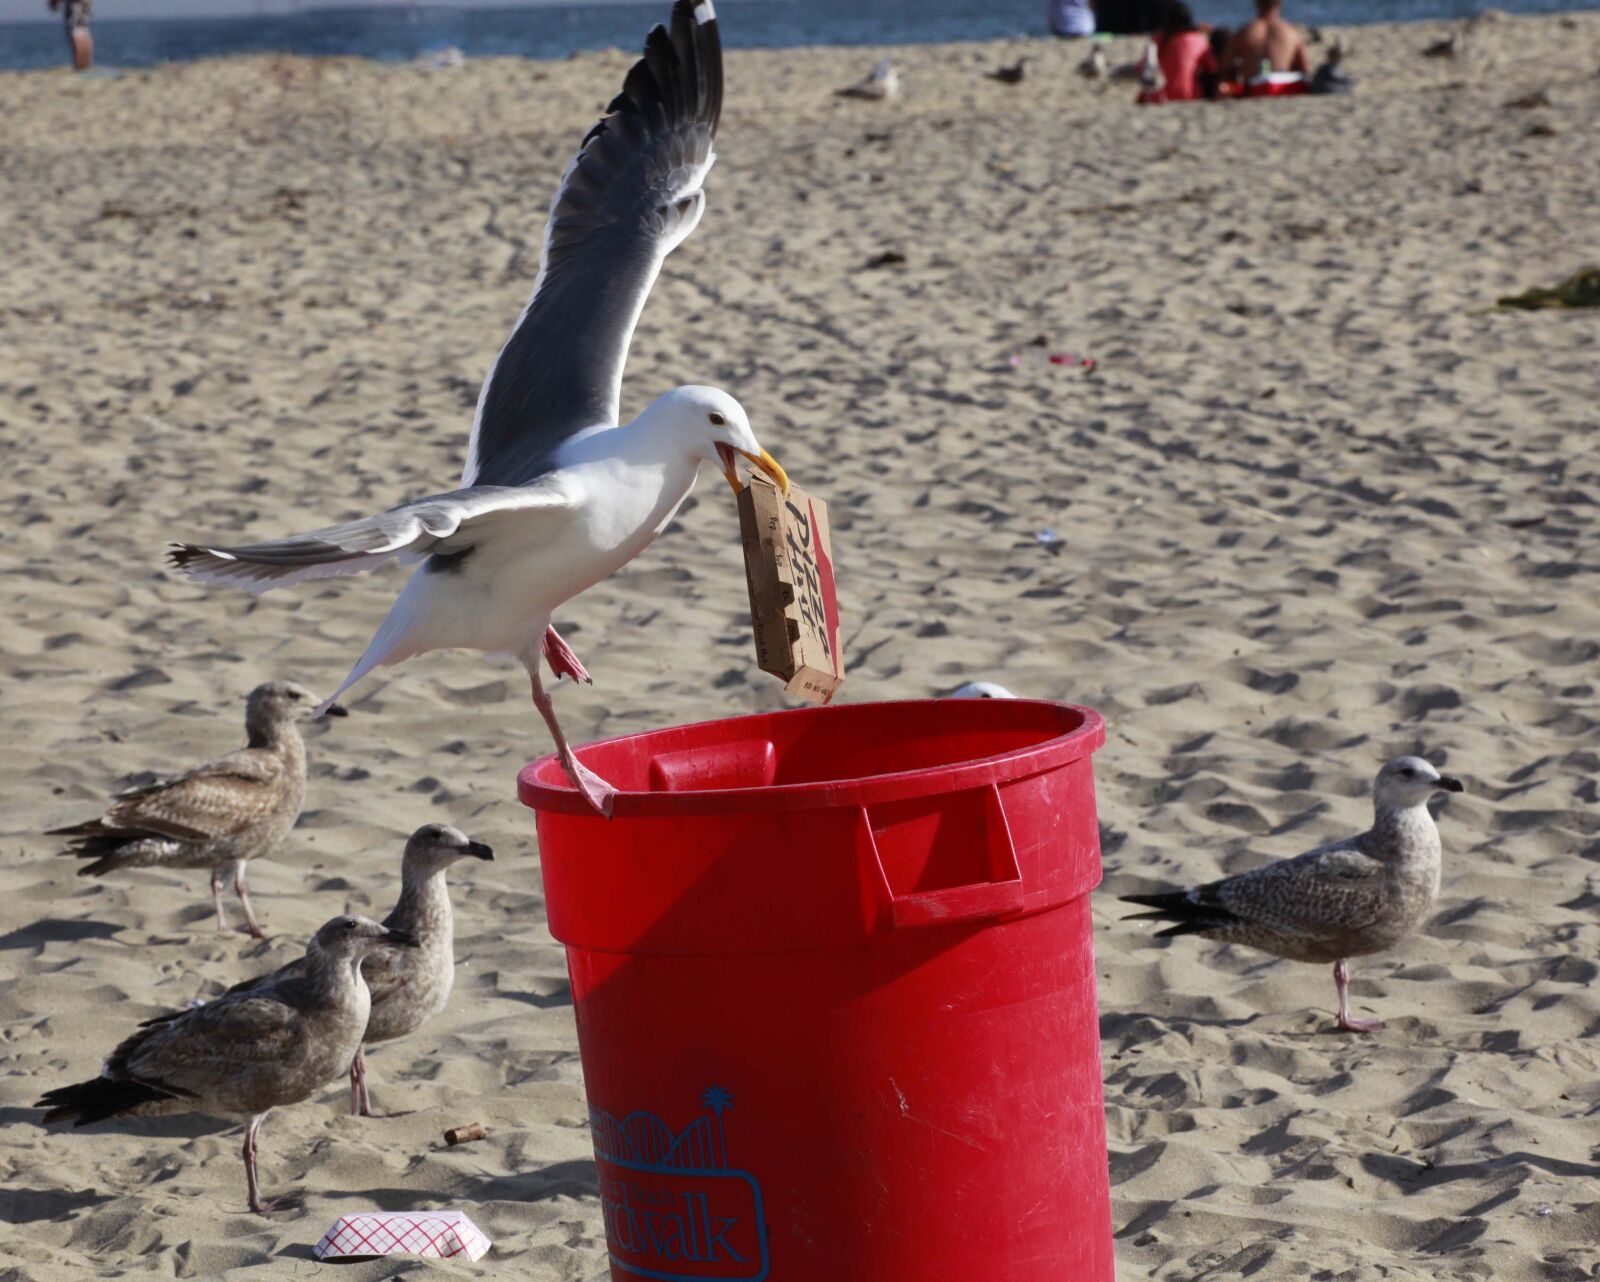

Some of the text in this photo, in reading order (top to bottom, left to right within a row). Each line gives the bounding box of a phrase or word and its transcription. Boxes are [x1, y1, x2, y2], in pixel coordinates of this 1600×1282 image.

[785, 500, 830, 659] Pizza
[786, 527, 816, 637] Hut
[600, 1182, 751, 1262] rdwalk
